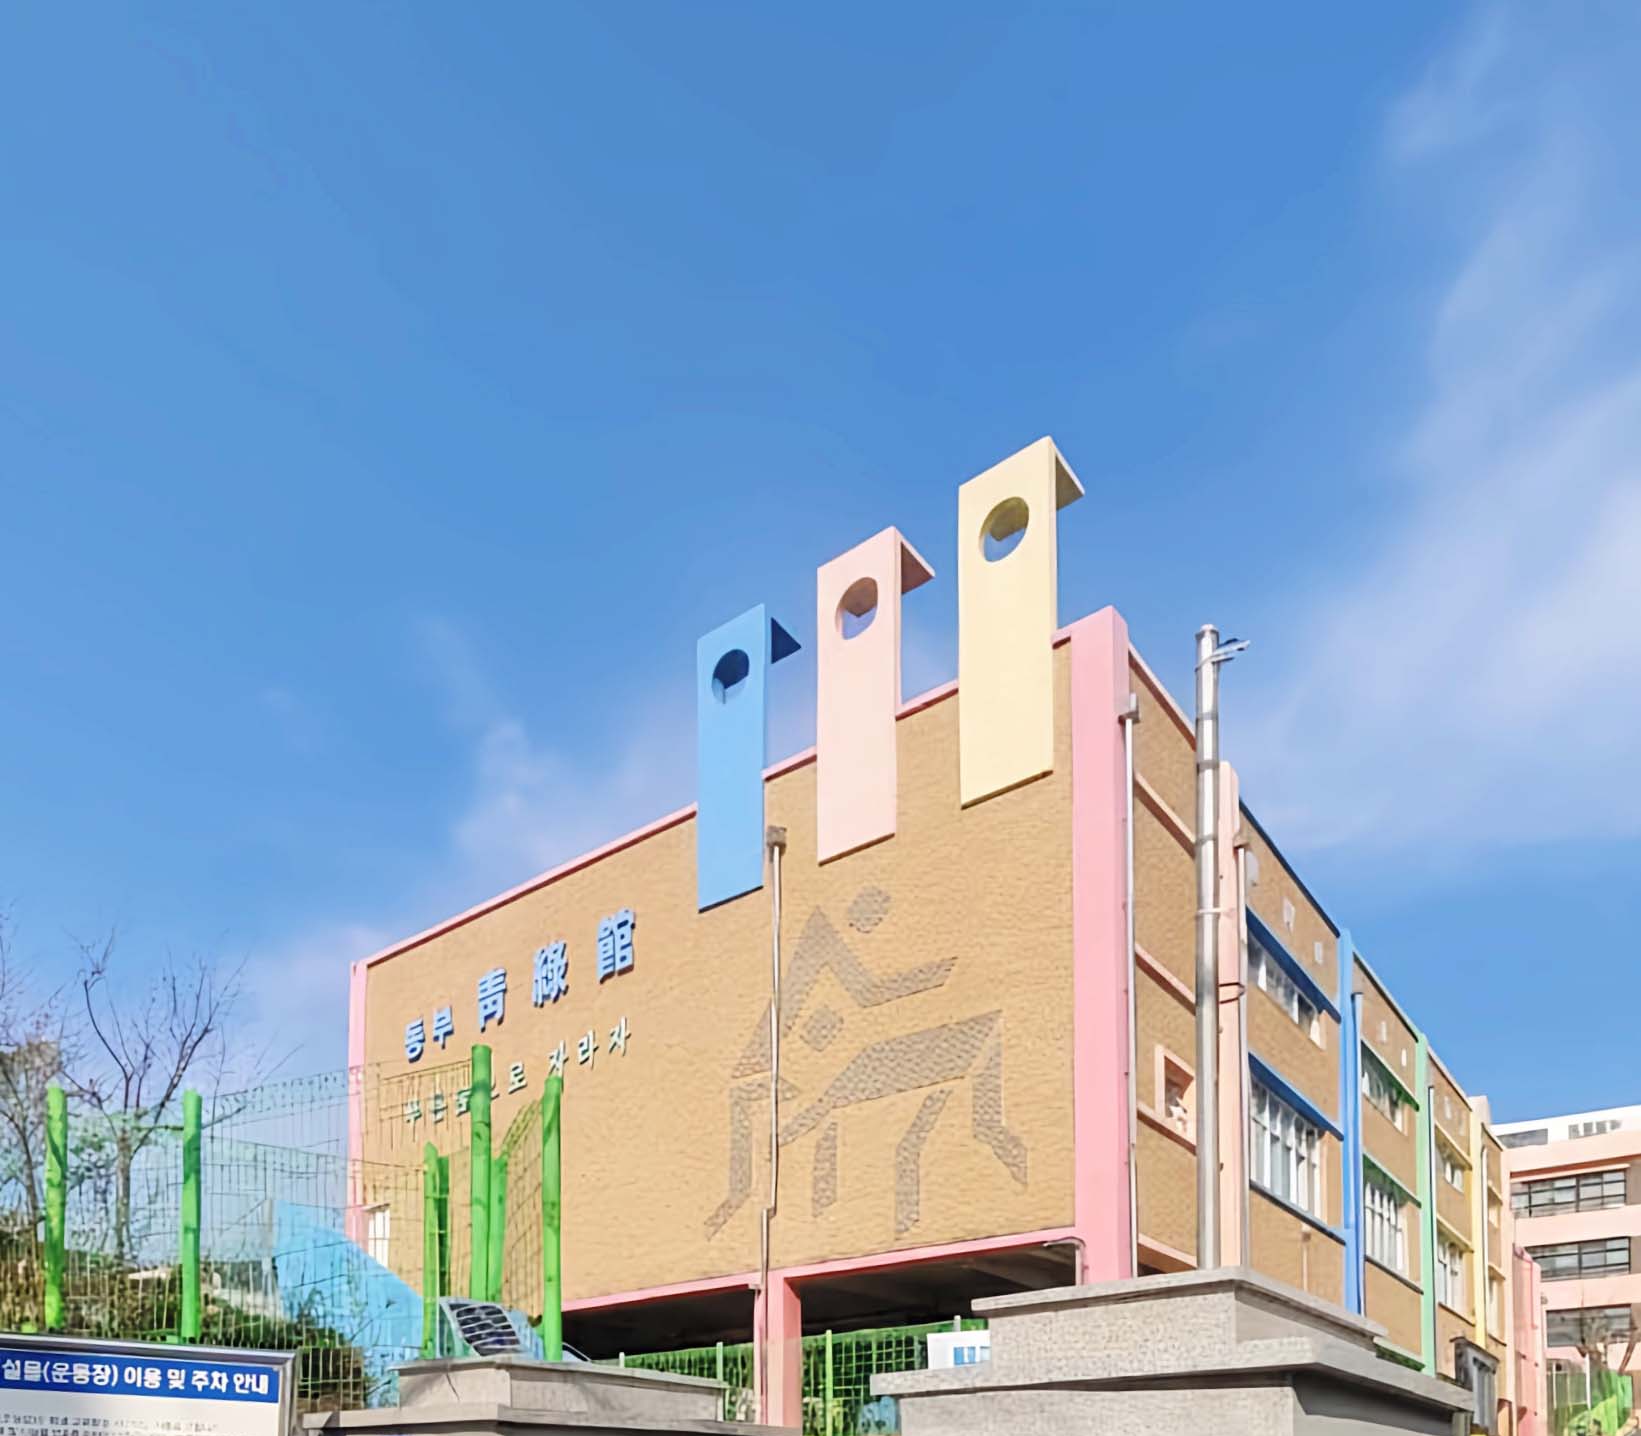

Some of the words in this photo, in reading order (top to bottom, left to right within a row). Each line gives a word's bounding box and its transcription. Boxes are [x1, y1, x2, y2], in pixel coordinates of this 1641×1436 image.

[548, 1016, 631, 1078] 자라자
[124, 1366, 161, 1389] 이용
[167, 1370, 185, 1390] 및
[192, 1371, 229, 1393] 주차
[233, 1374, 269, 1395] 안내
